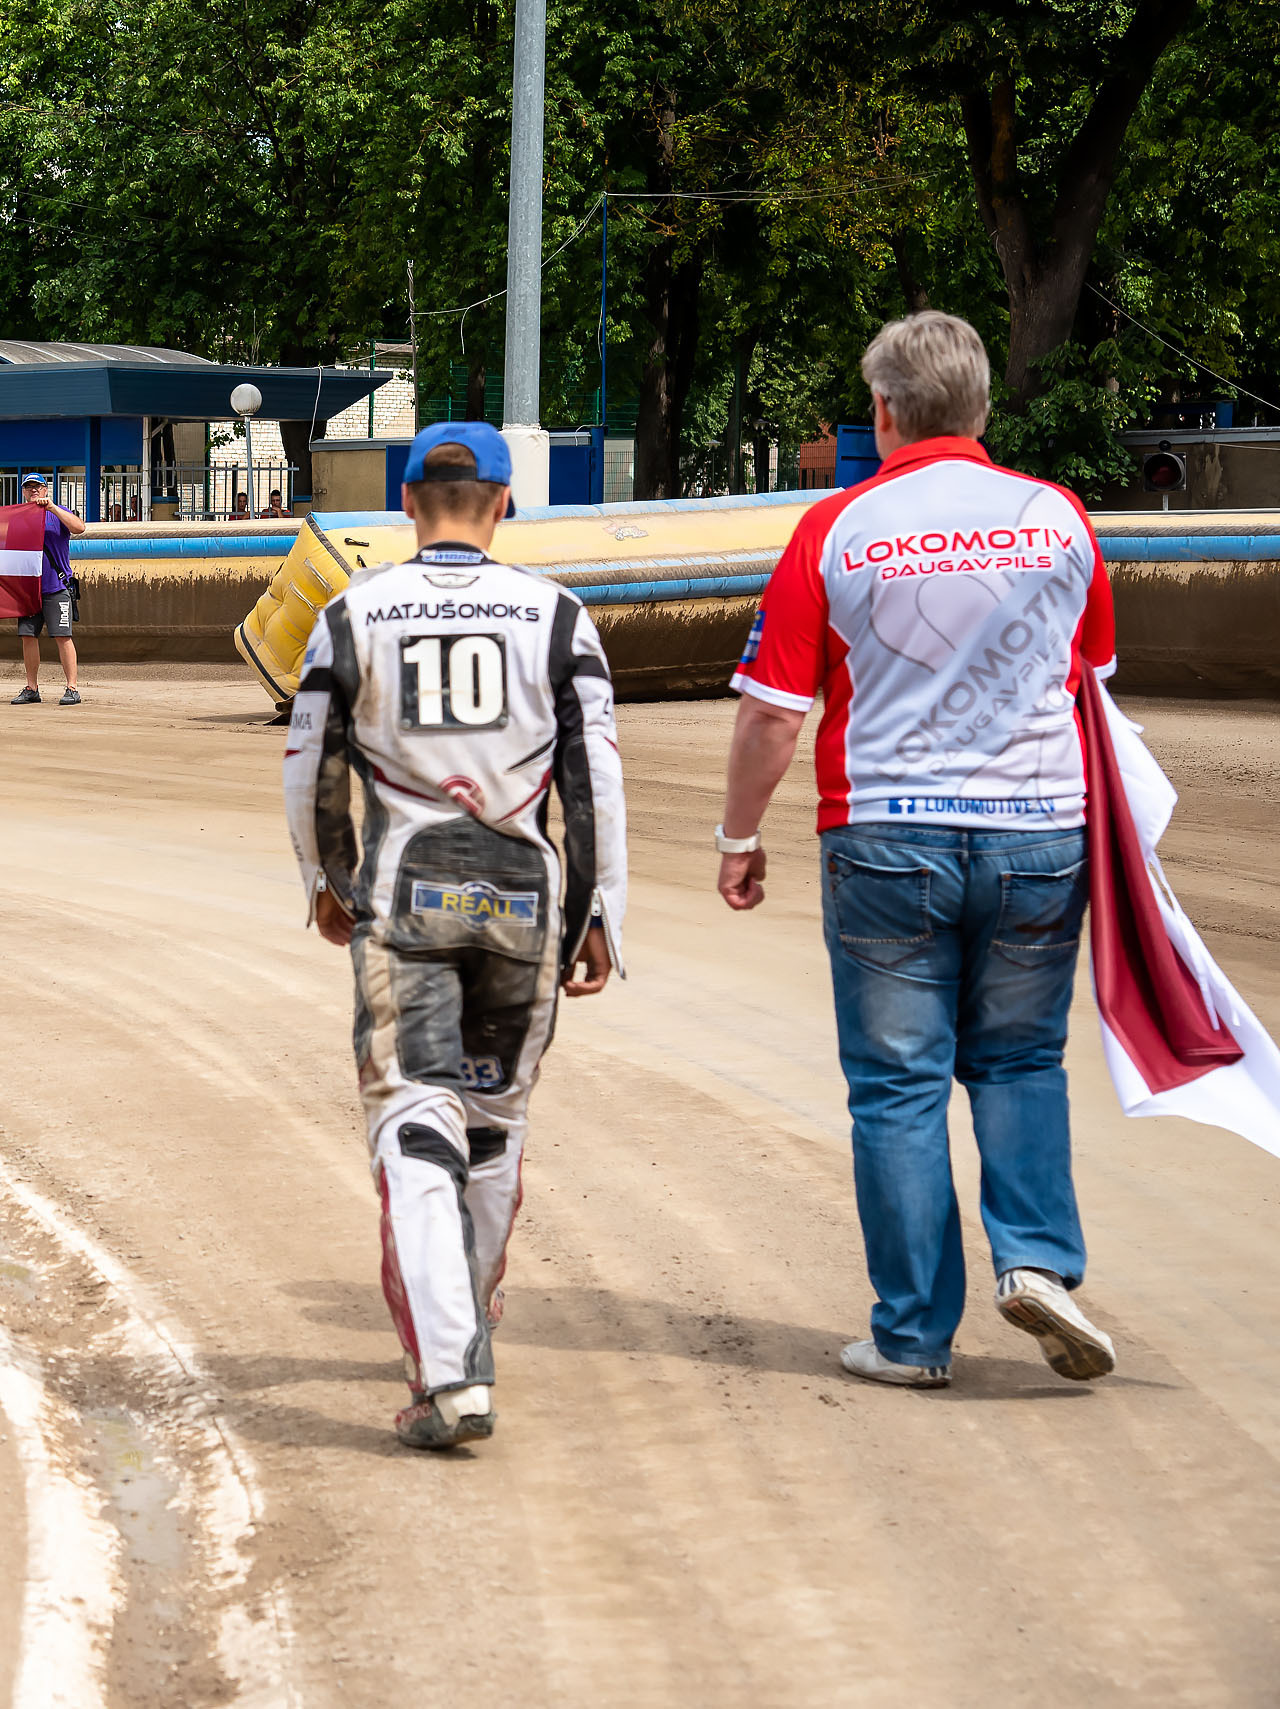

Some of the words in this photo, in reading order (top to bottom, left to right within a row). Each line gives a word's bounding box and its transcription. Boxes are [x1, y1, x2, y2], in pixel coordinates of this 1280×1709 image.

[843, 528, 1073, 571] LOKOMOTIV
[881, 555, 1053, 581] DAUGAVPILS
[365, 599, 540, 626] MATJUŠONOKS
[402, 635, 504, 726] 10
